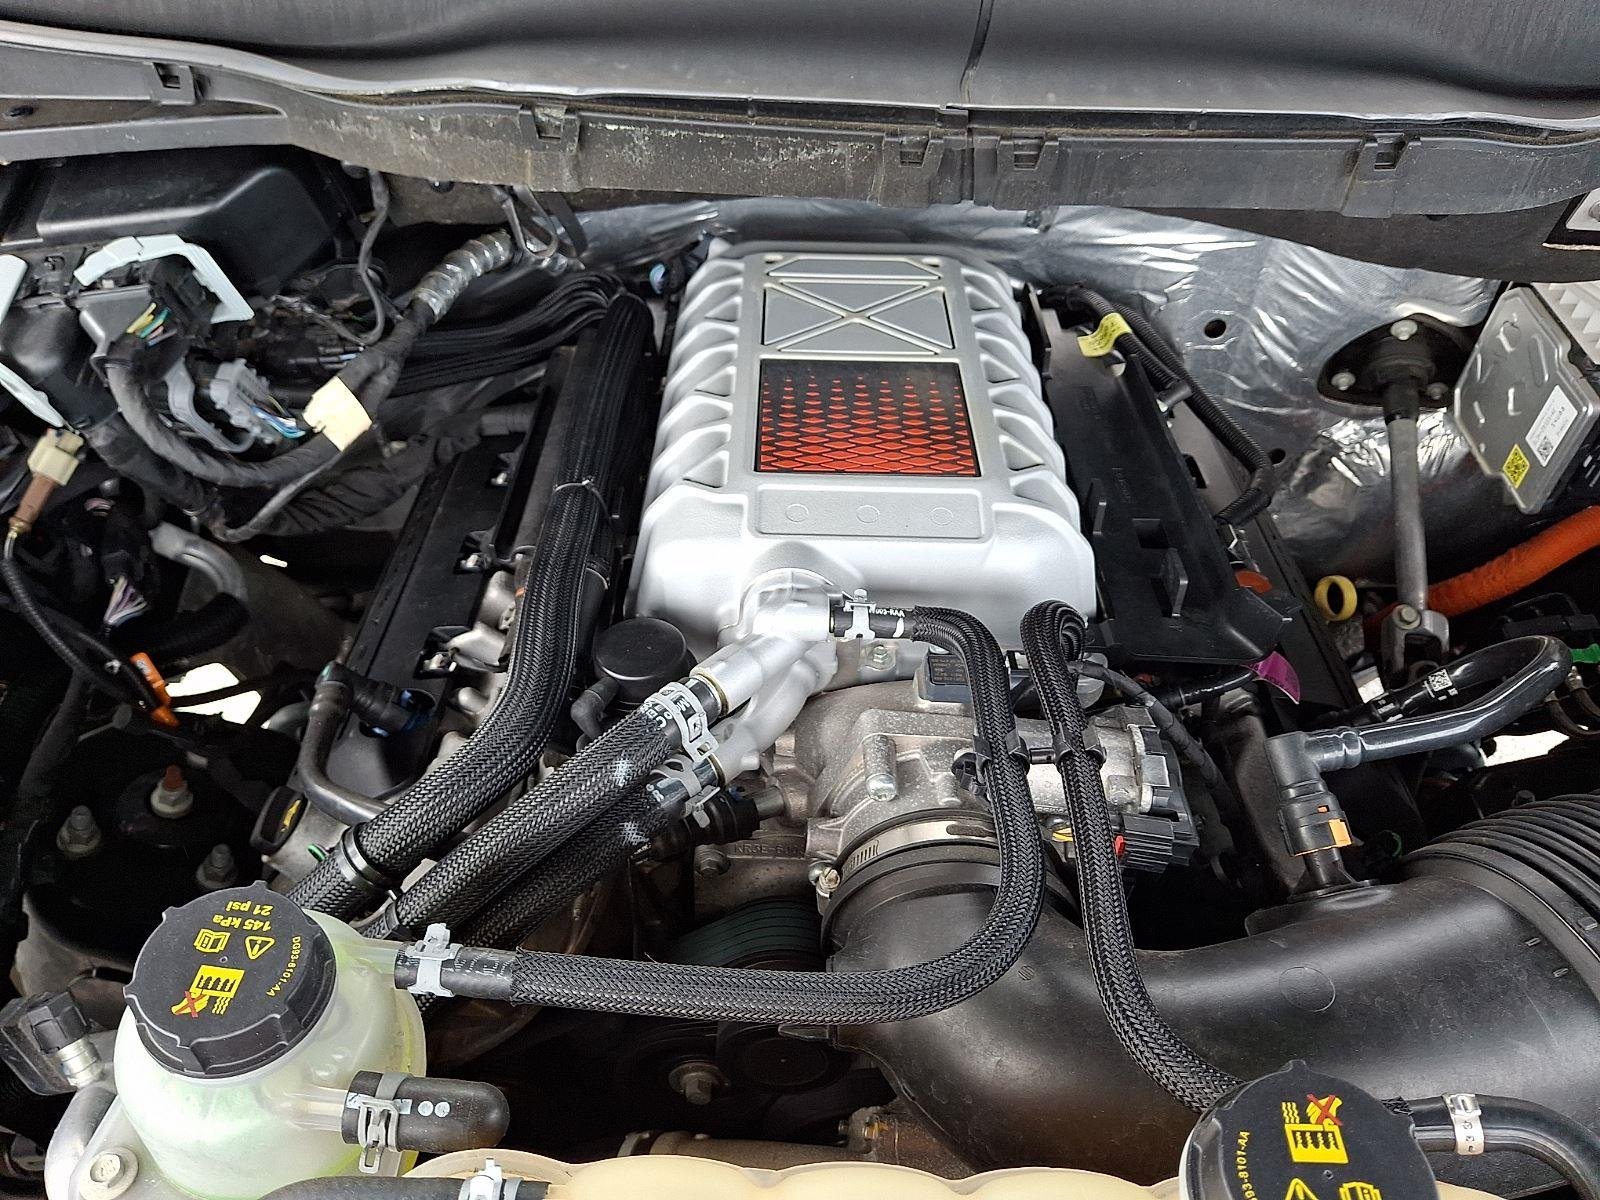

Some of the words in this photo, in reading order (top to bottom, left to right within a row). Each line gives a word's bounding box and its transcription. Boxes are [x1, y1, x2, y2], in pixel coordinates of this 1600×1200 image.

[226, 901, 251, 911] psi
[253, 905, 273, 916] 21
[213, 914, 242, 928] kPa
[243, 919, 271, 931] 145
[266, 936, 301, 997] DG93-8101-AA
